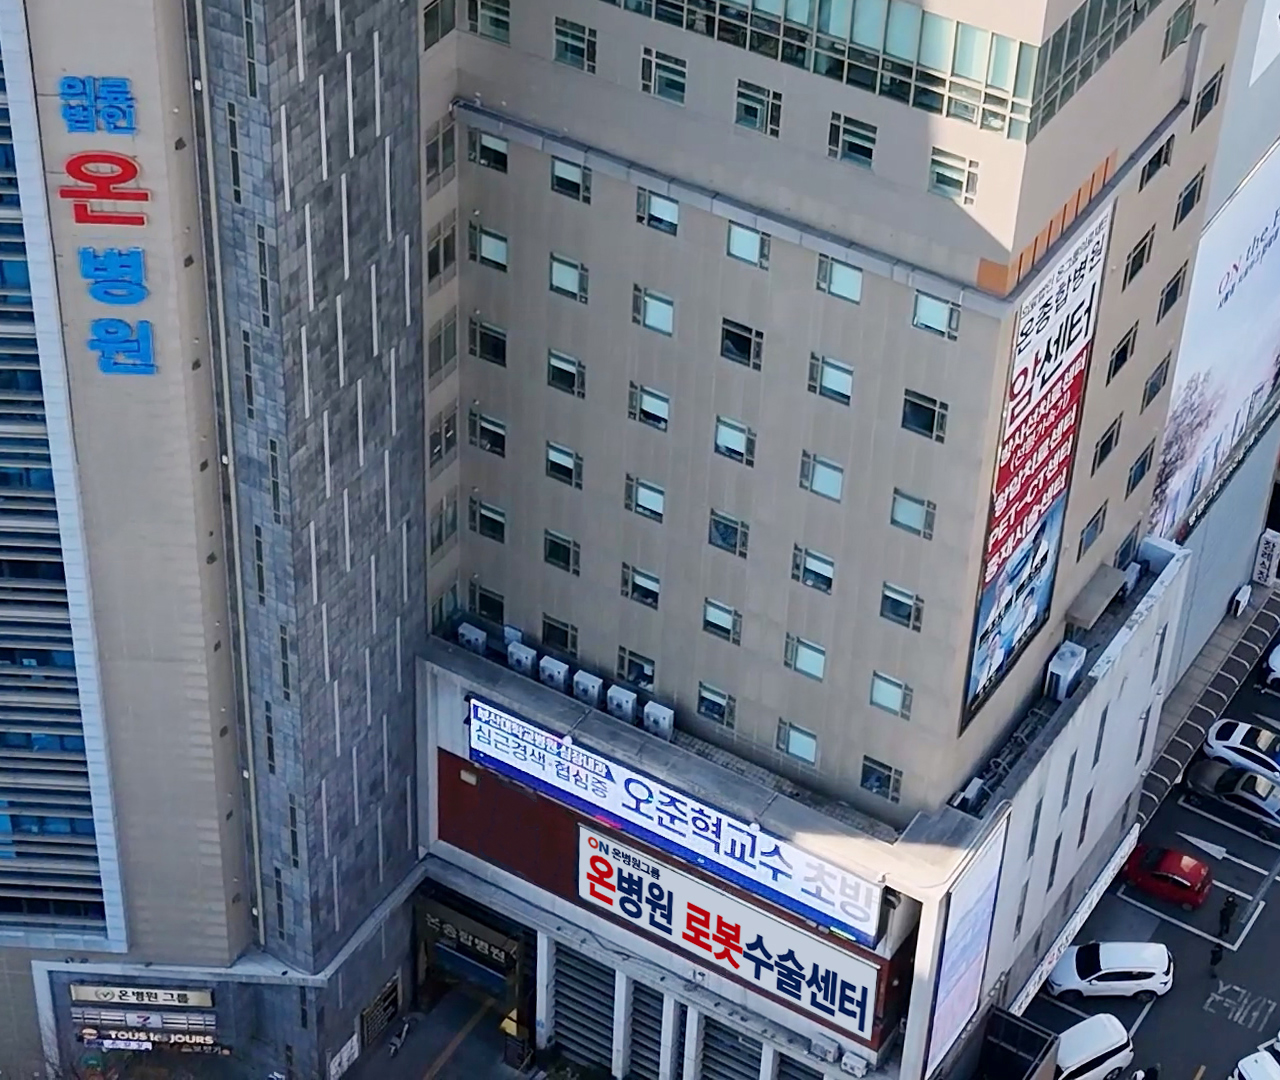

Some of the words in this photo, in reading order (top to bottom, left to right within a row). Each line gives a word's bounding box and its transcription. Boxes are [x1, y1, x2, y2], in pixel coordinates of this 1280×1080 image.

[58, 150, 158, 376] 온병원
[1246, 226, 1269, 261] the
[1017, 232, 1104, 355] 온종합병원
[1010, 280, 1096, 426] 암센터
[588, 836, 609, 856] ON
[612, 847, 661, 880] 온병원그룹
[586, 854, 674, 936] 온병원
[682, 901, 868, 1032] 로봇수술센터
[108, 1029, 148, 1041] TOUS
[169, 1034, 214, 1045] JOURS
[118, 989, 160, 1003] 온병원
